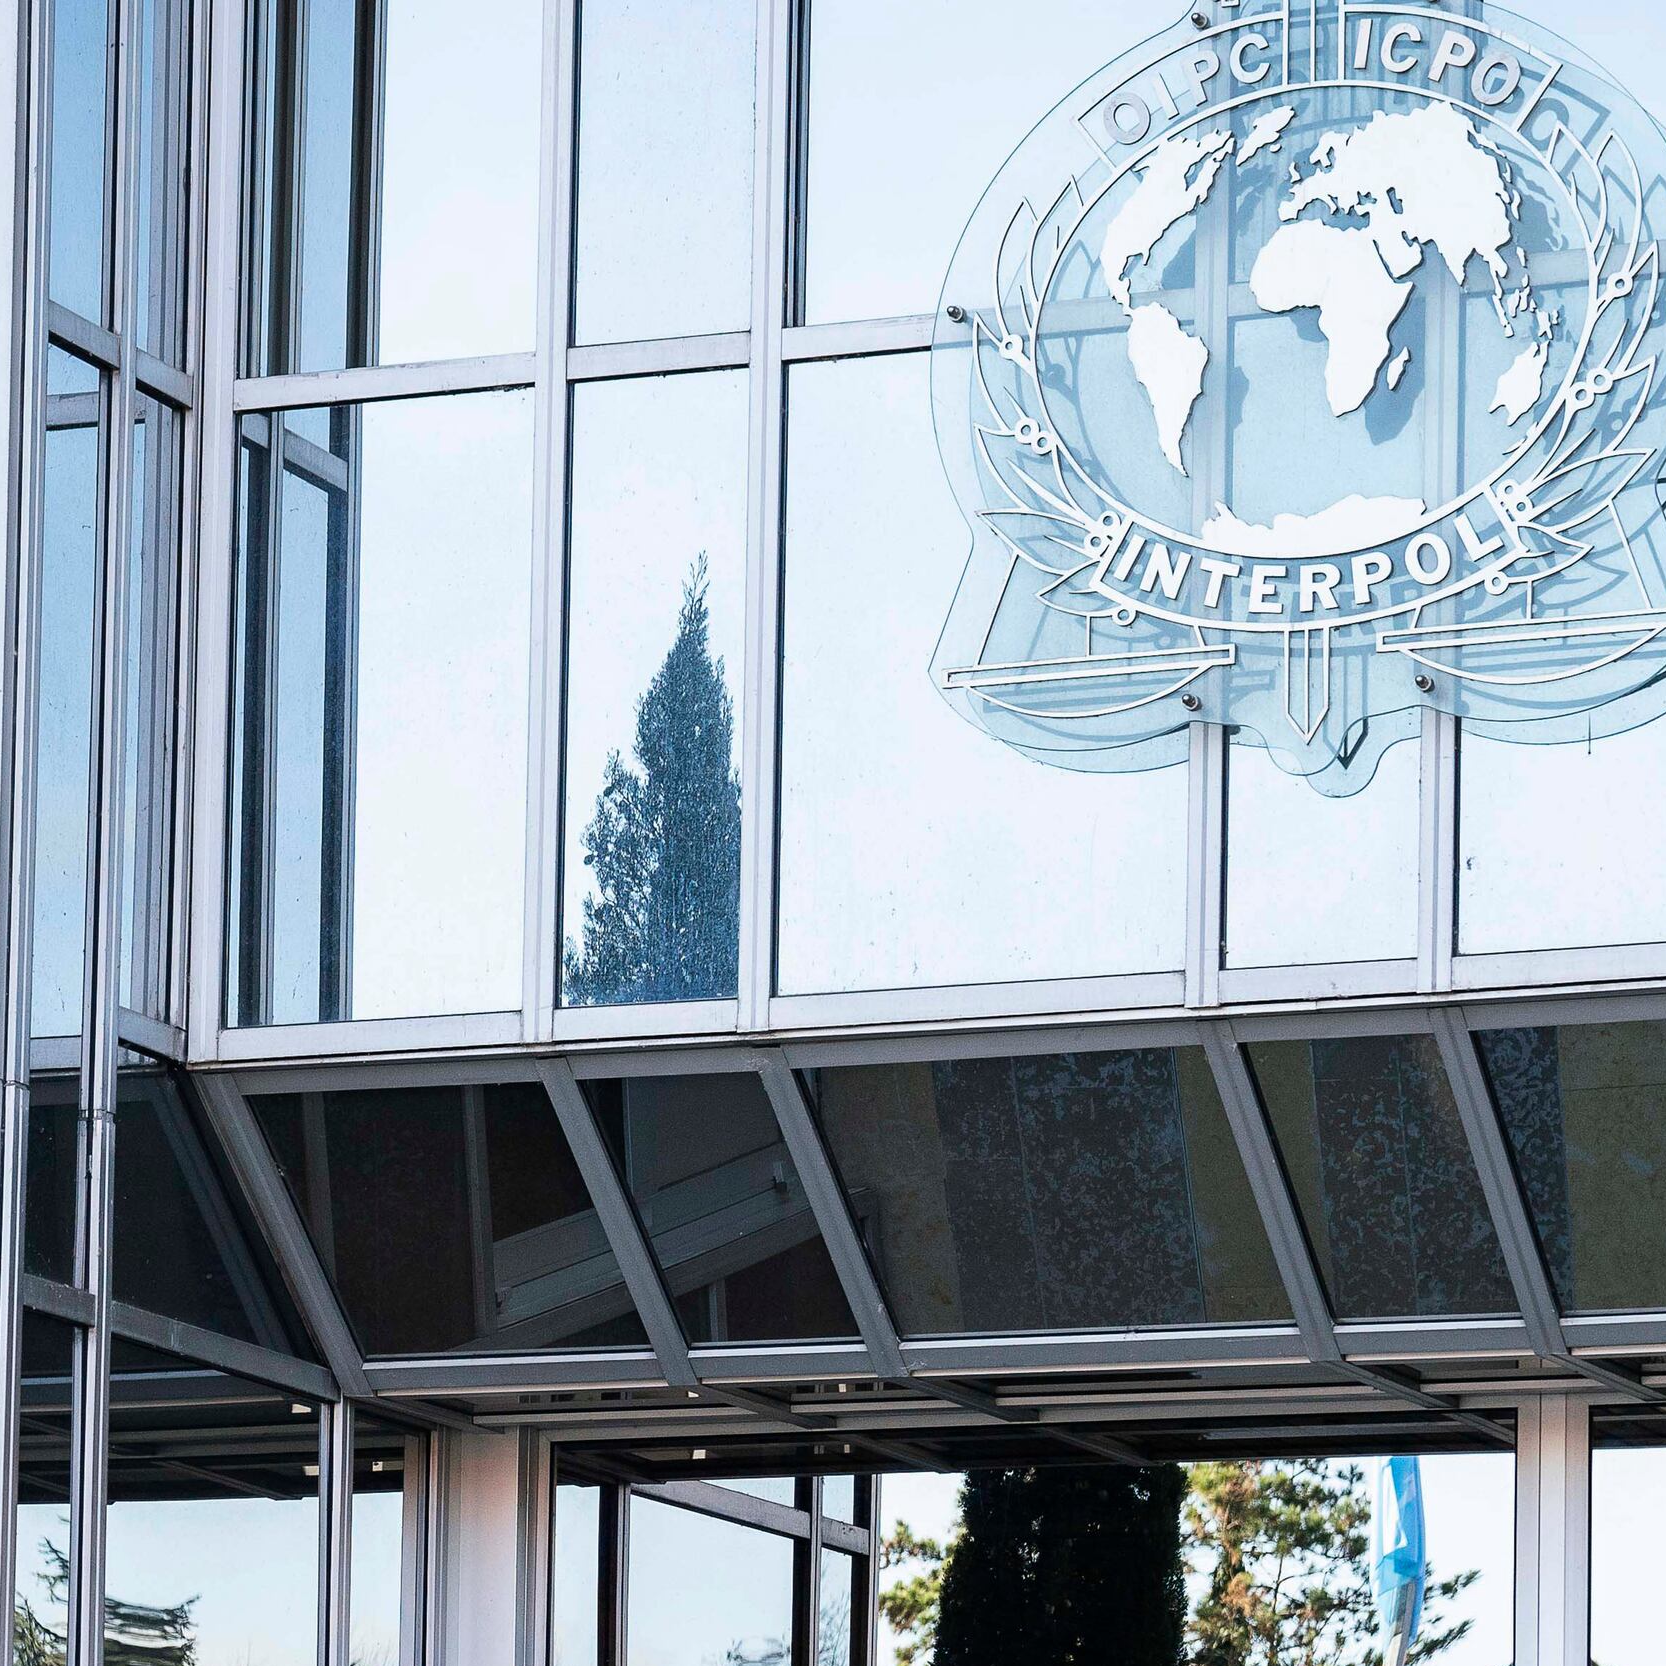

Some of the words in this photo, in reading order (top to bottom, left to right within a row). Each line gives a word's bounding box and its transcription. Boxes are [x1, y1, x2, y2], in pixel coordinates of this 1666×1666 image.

[1102, 34, 1271, 145] OIPC
[1353, 18, 1521, 106] ICPO
[1113, 513, 1503, 614] INTERPOL
